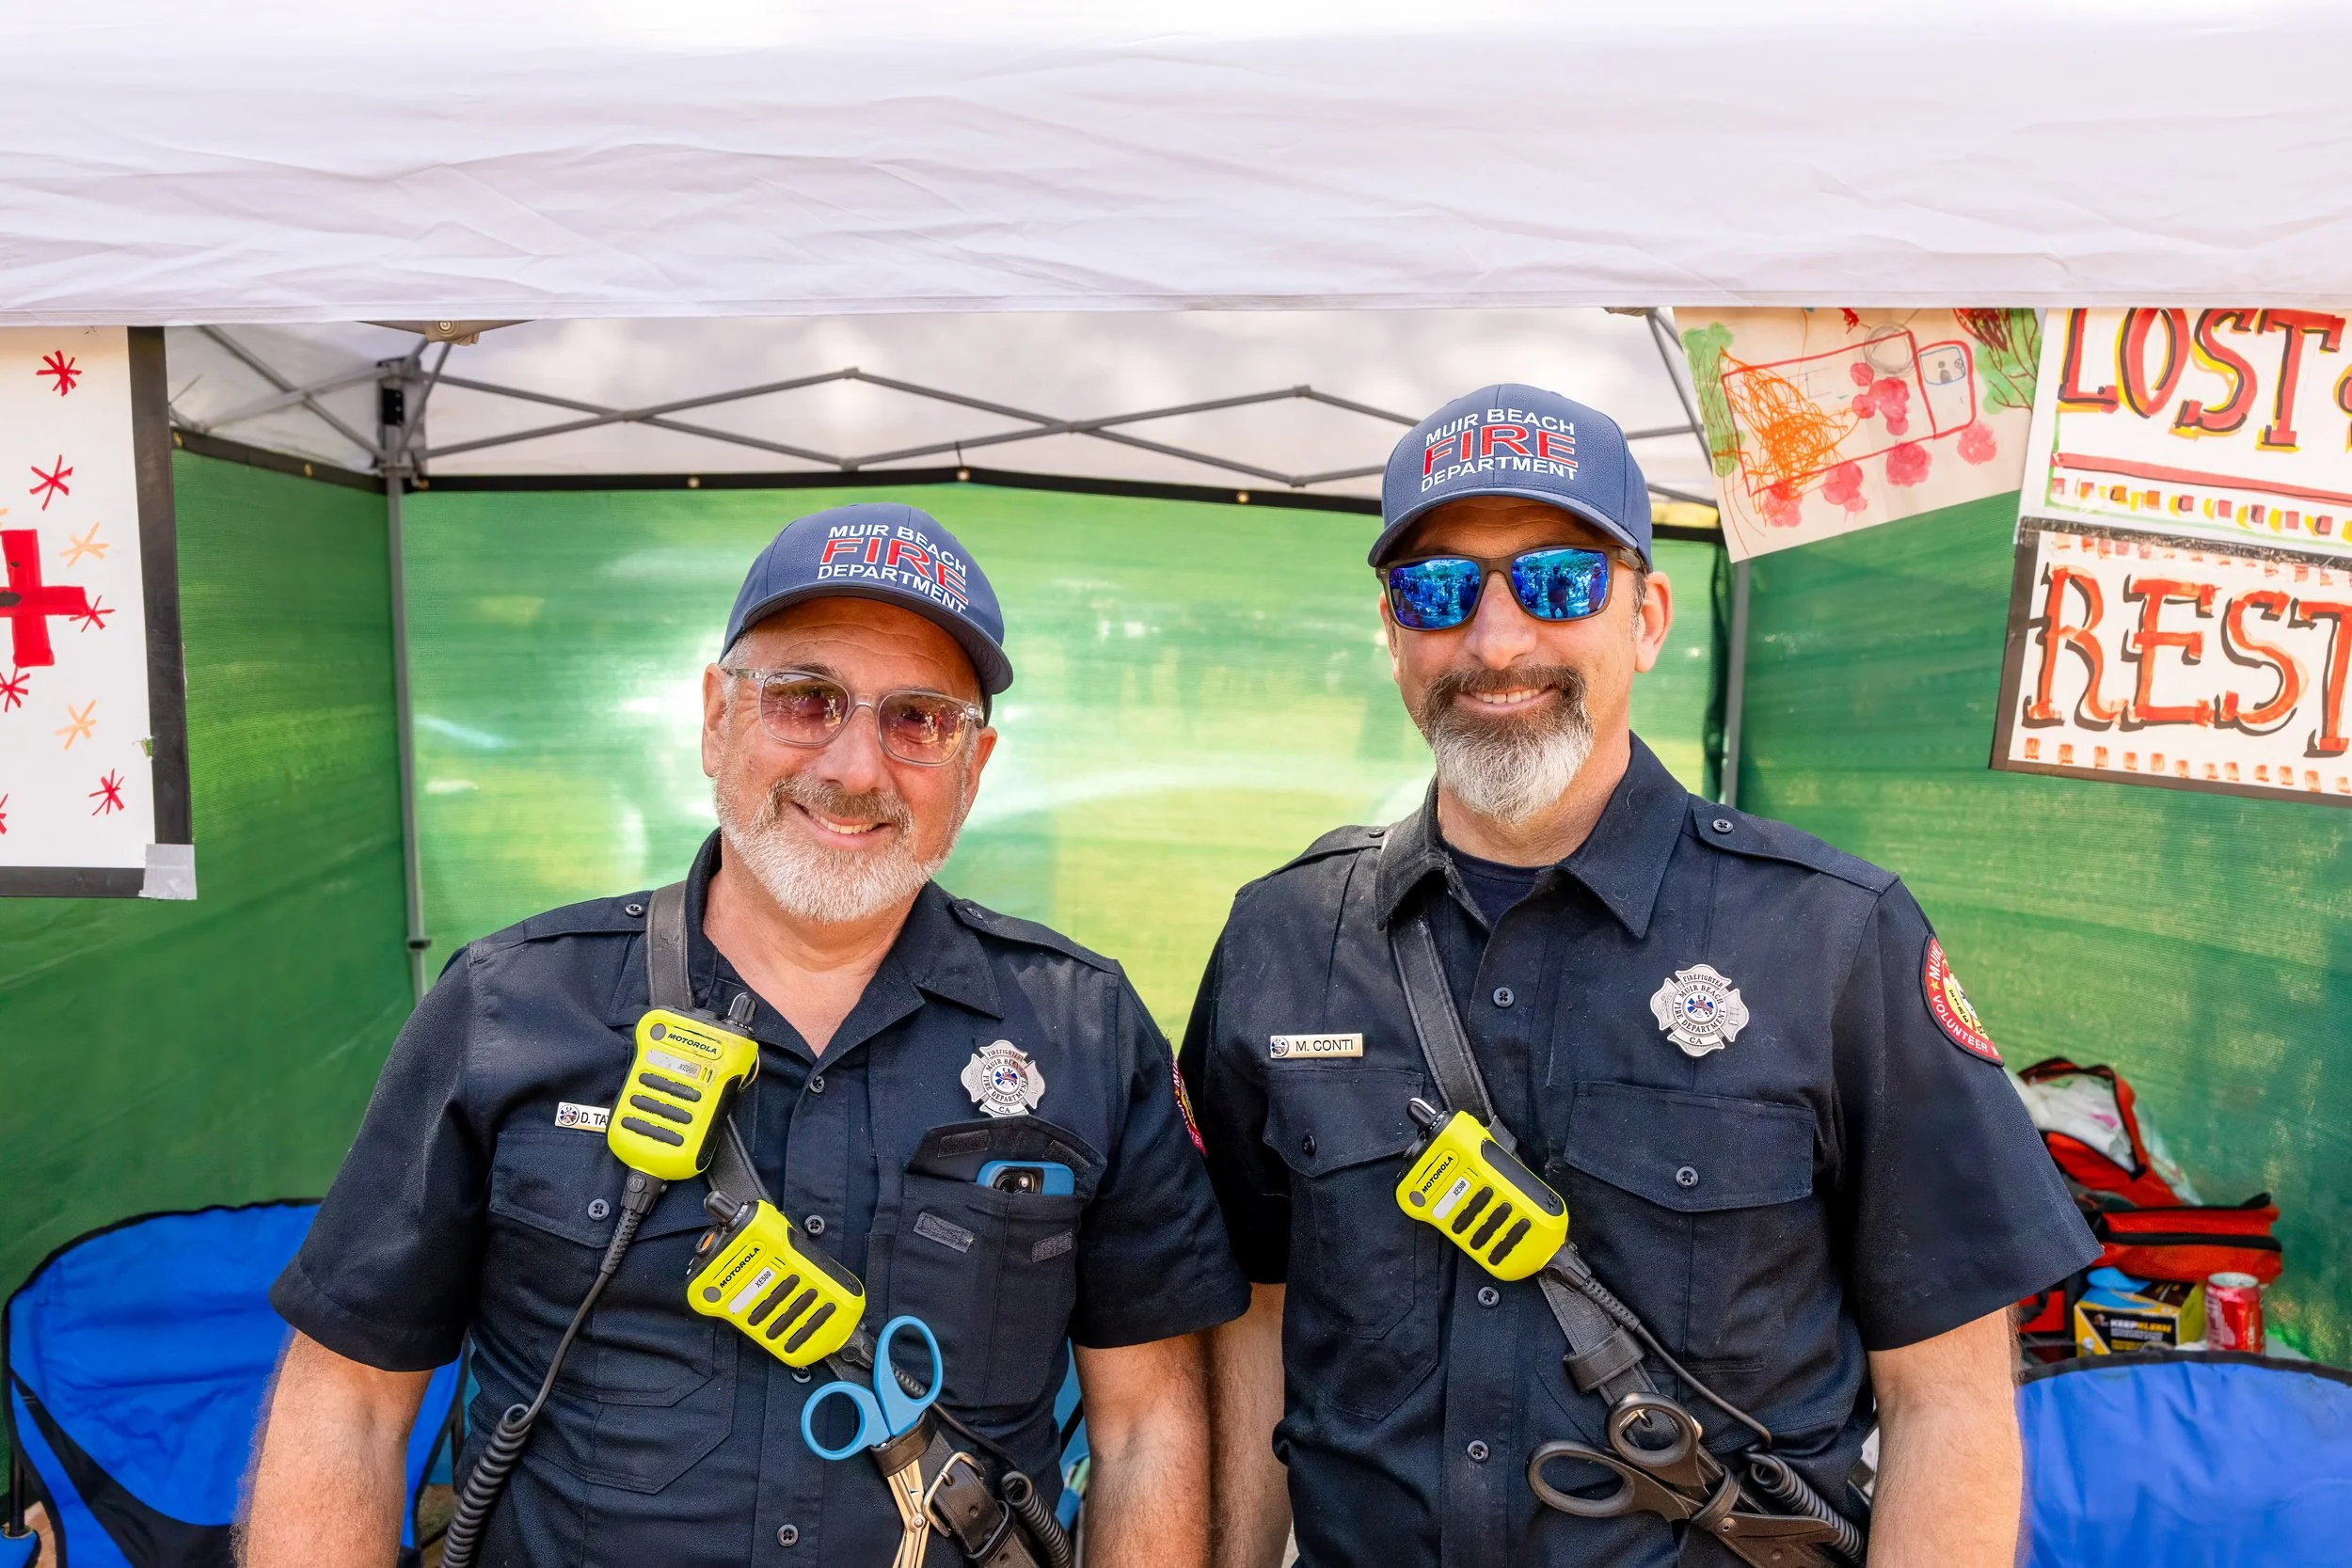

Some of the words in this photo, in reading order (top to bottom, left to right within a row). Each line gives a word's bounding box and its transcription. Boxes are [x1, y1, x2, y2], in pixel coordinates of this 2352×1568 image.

[2057, 309, 2345, 451] LOST
[1425, 413, 1479, 447] MUIR
[1486, 408, 1575, 436] BEACH
[1422, 423, 1578, 478] FIRE
[1421, 456, 1578, 493] DEPARTMENT
[828, 524, 889, 538] MUIR
[897, 526, 966, 578] BEACH
[817, 564, 966, 614] DEPARTMENT
[819, 537, 968, 606] FIRE
[2022, 562, 2352, 758] REST
[1683, 974, 1724, 988] FIREFIGHTER
[1929, 943, 1943, 981] MUIR
[1678, 985, 1699, 998] MUIR
[1701, 985, 1724, 1004] BEACH
[1675, 1002, 1683, 1020] FIRE
[1681, 1009, 1726, 1033] DEPARTMENT
[1932, 995, 1989, 1053] VOLUNTEER
[668, 1033, 717, 1054] MOTOROLA
[1295, 1040, 1310, 1052] M.
[1313, 1039, 1354, 1051] CONTI
[986, 1058, 1002, 1071] MUIR
[983, 1075, 993, 1091] FIRE
[991, 1080, 1028, 1102] DEPARTMENT
[580, 1112, 591, 1124] D.
[593, 1113, 610, 1126] TA
[1422, 1156, 1454, 1194] MOTOROLA
[719, 1247, 760, 1288] MOTOROLA
[755, 1270, 772, 1288] XE500
